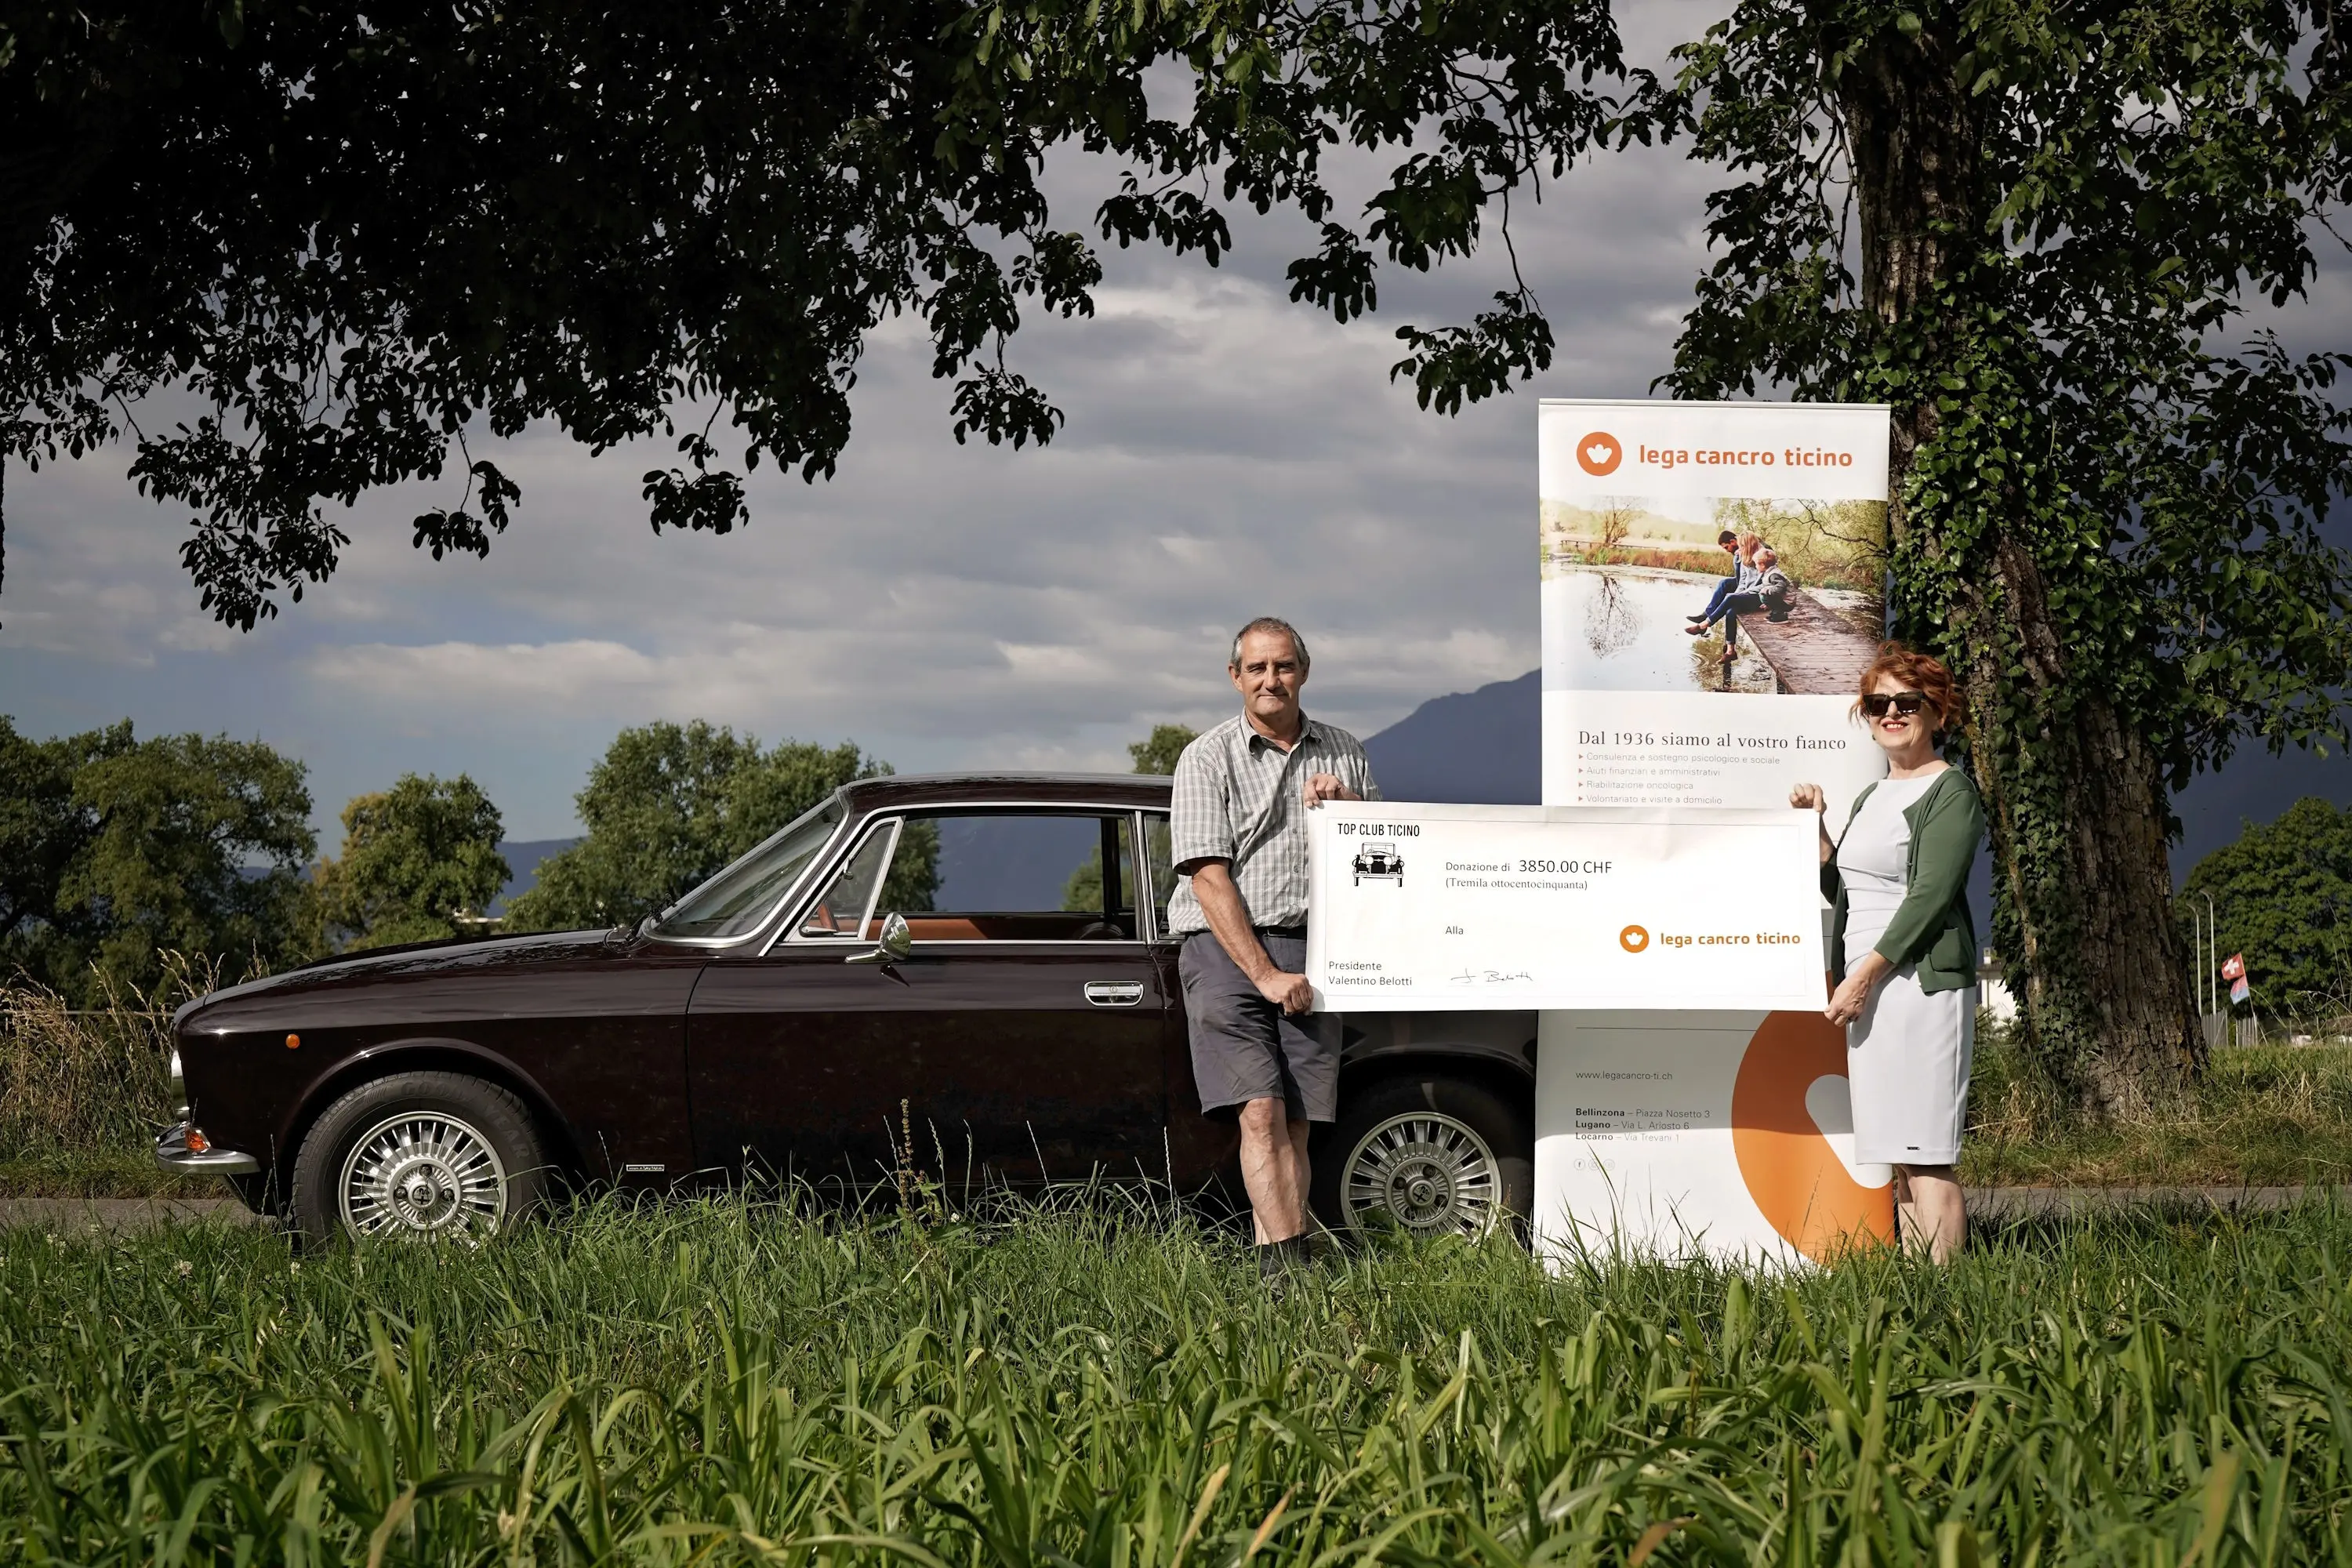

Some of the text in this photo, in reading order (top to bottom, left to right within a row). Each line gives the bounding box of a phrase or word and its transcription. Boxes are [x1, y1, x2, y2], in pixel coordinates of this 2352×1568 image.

[1639, 445, 1853, 469] lega cancro ticino
[1579, 731, 1846, 750] Dal 1936 siamo al vostro fianco
[1586, 752, 1637, 761] Consulenza
[1648, 754, 1689, 763] sostegno
[1691, 754, 1740, 764] psicologico
[1586, 766, 1606, 775] Aiuti
[1586, 780, 1693, 791] Riabilitazione oncologica
[1586, 794, 1639, 803] Volontariato
[1683, 796, 1722, 804] domicilio
[1337, 822, 1420, 837] TOP CLUB TICINO
[1446, 859, 1613, 873] Donazione di 3850.00 CHF
[1446, 877, 1588, 891] (Tremila ottocentocinquanta)
[1445, 925, 1464, 935] Alla
[1661, 931, 1801, 949] lega cancro ticino
[1329, 960, 1382, 971] Presidente
[1328, 975, 1413, 986] Valentino Belotti
[1575, 1070, 1673, 1081] www.legacancro-ti.ch
[1576, 1108, 1625, 1116] Bellinzona
[1635, 1109, 1663, 1117] Piazza
[1666, 1109, 1702, 1119] Nosetto
[1704, 1109, 1711, 1119] 3
[1575, 1120, 1611, 1130] Lugano
[1621, 1120, 1635, 1129] Via
[1648, 1120, 1681, 1130] Ariosto
[1683, 1121, 1690, 1131] 6
[1575, 1132, 1613, 1141] Locarno
[1624, 1132, 1638, 1141] Via
[1640, 1133, 1671, 1142] Trevani
